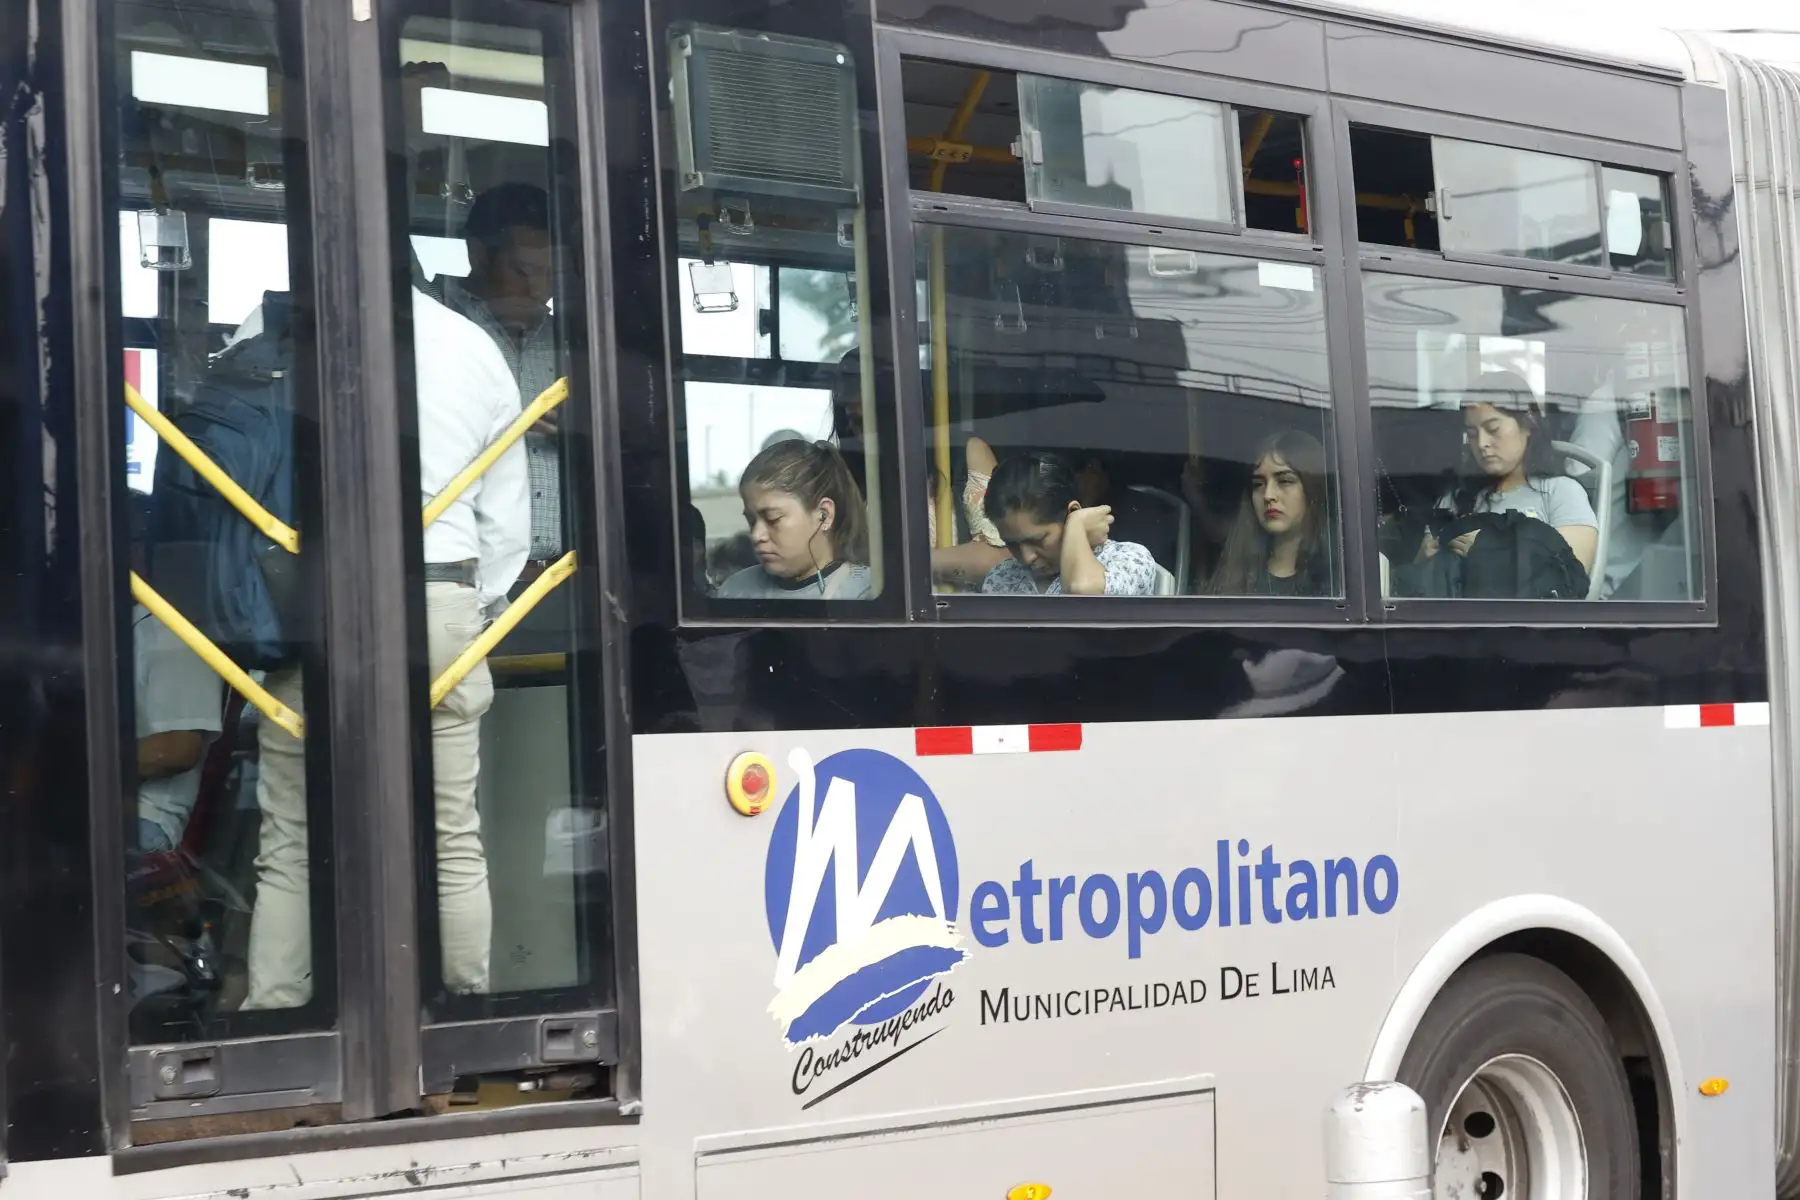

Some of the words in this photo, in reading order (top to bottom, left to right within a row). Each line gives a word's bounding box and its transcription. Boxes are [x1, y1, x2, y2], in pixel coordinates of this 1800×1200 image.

[980, 979, 1207, 1026] MUNICIPALIDAD
[1271, 961, 1336, 995] LIMA
[792, 982, 955, 1095] Construyendo
